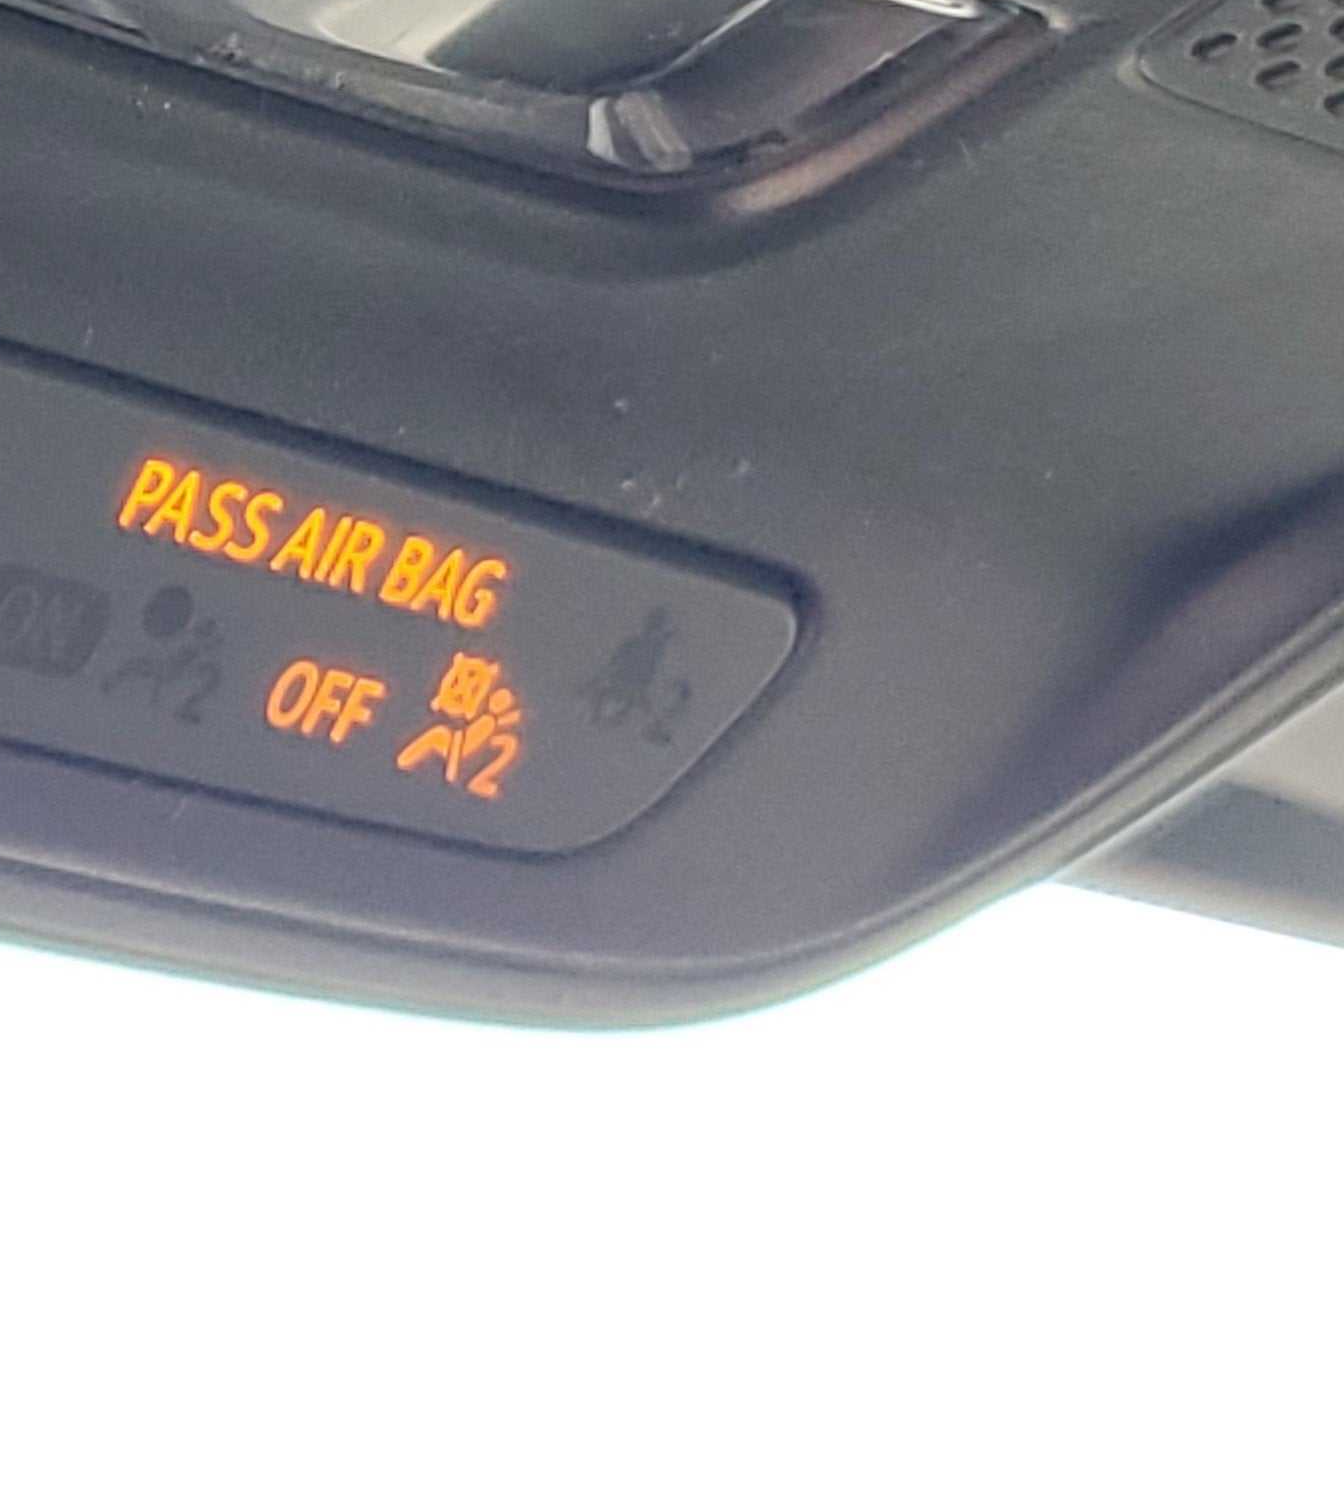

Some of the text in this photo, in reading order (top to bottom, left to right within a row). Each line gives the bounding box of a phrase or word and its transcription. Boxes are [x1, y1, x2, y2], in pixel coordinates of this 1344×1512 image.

[118, 457, 509, 628] PASS AIR BAG
[267, 659, 385, 740] OFF
